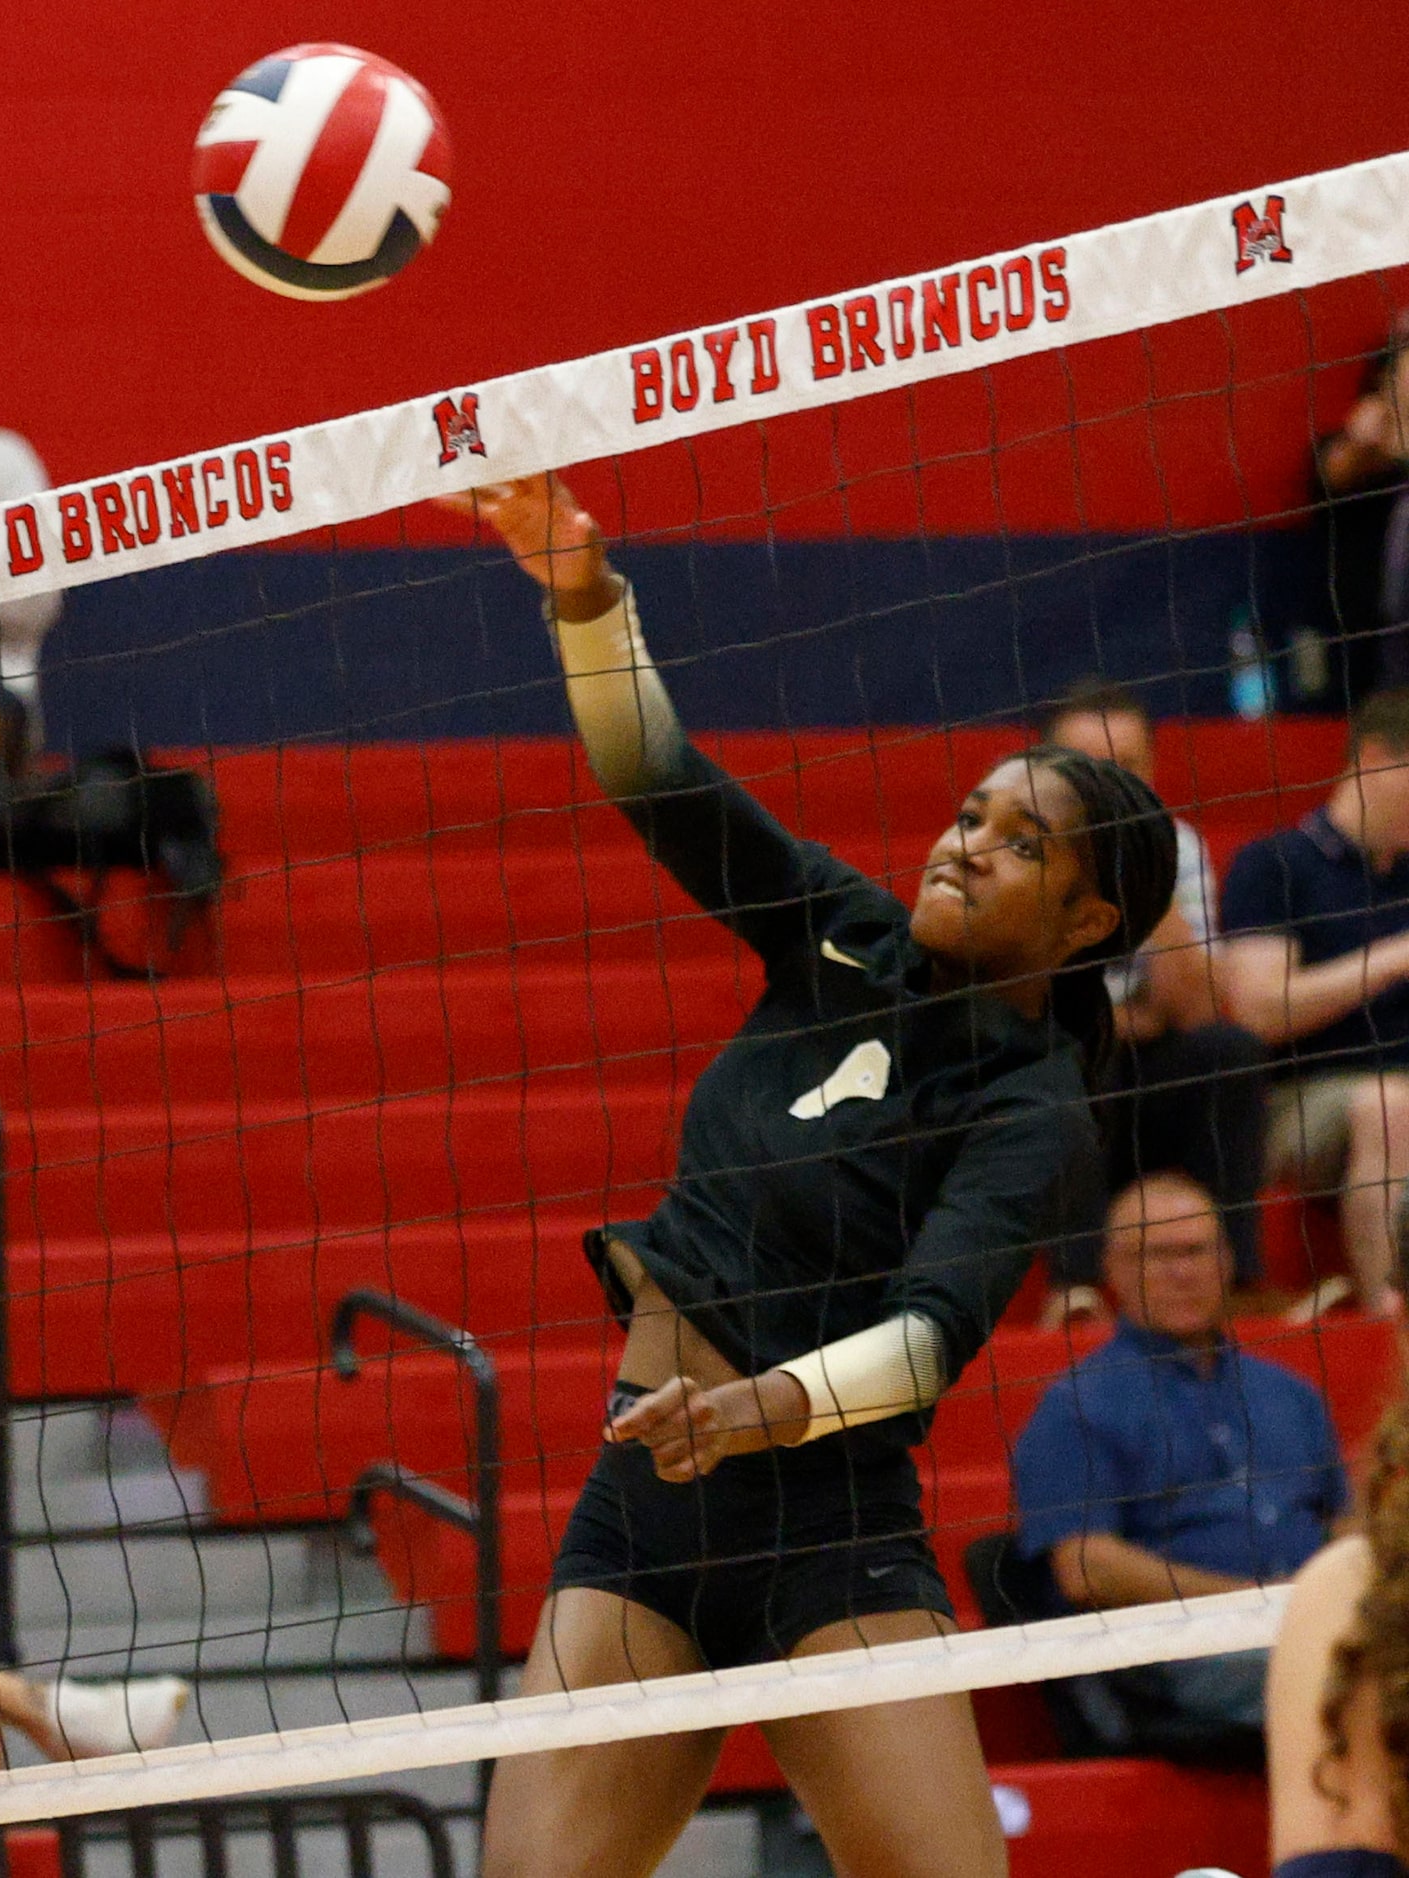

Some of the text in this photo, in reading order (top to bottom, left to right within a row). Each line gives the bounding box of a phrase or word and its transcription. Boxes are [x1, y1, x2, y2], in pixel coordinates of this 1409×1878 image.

[1232, 195, 1293, 275] M
[631, 246, 1072, 424] BOYD BRONCOS
[433, 392, 487, 467] M
[59, 441, 293, 563] BRONCOS
